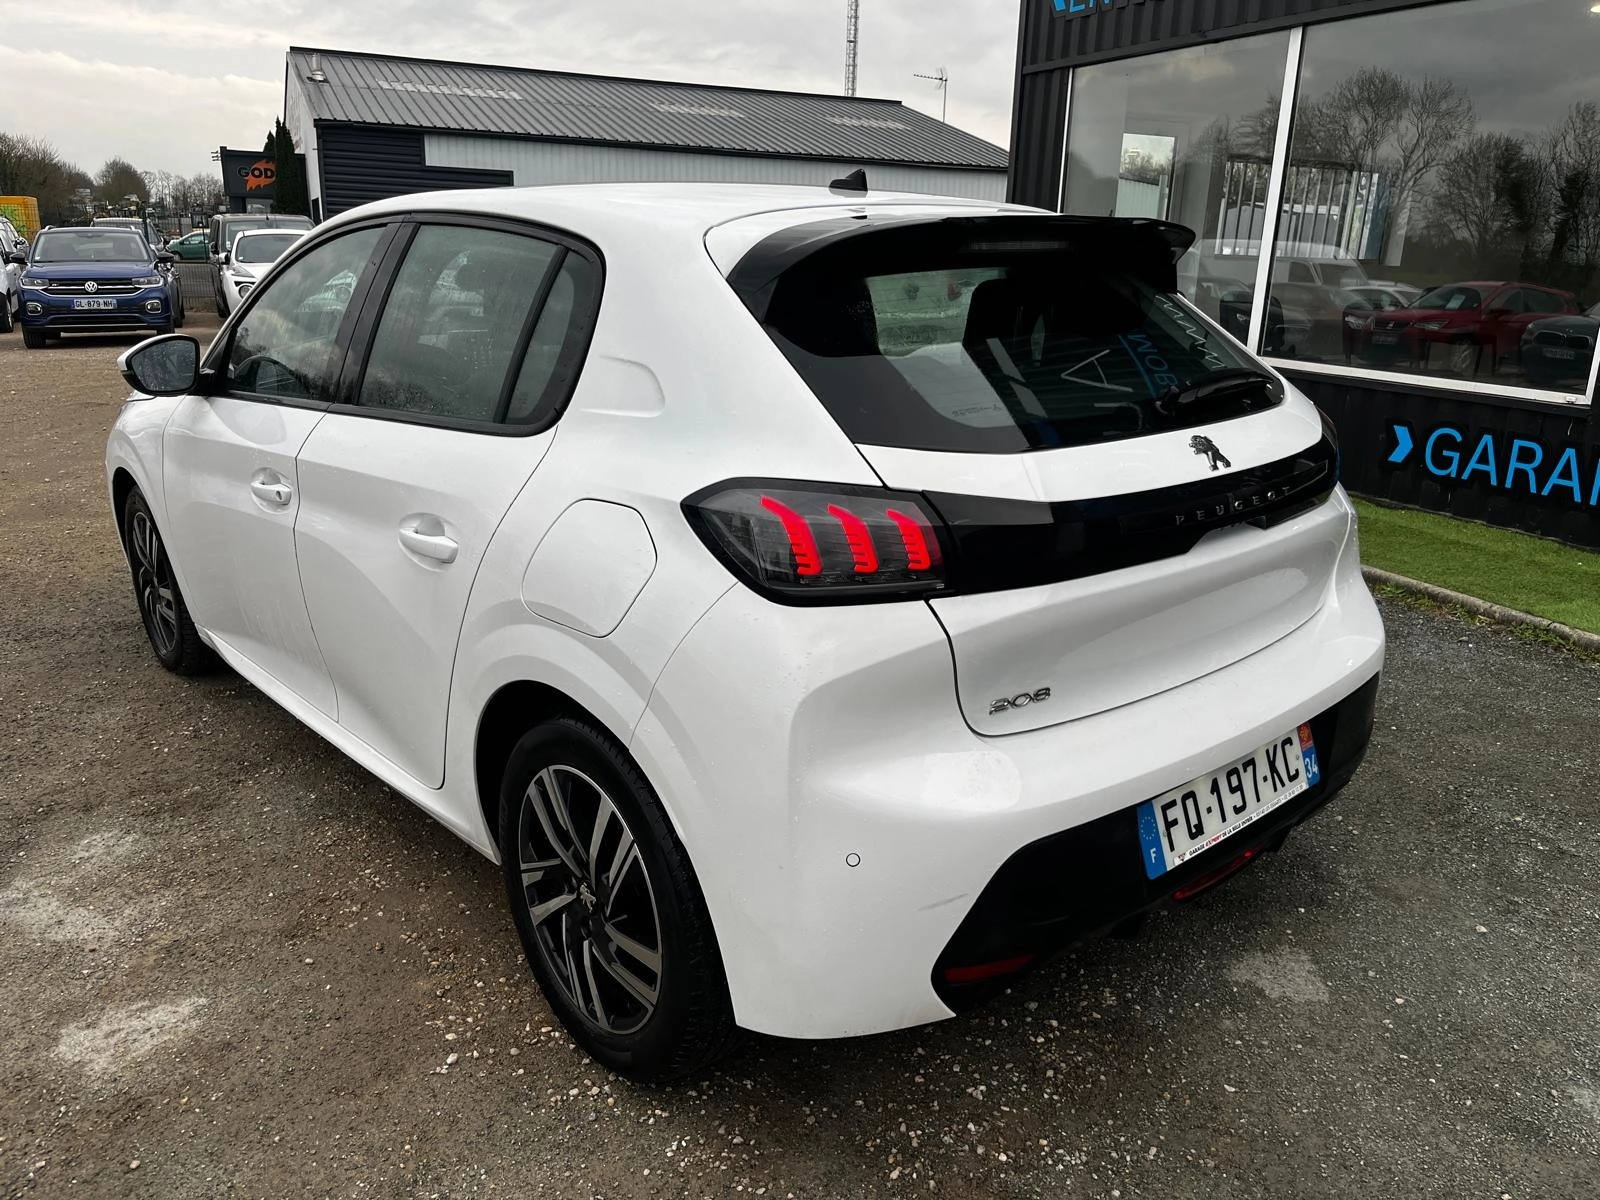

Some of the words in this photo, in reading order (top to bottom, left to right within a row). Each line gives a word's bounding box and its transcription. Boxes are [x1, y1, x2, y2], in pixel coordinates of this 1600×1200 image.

[1175, 485, 1291, 526] PEUGEOT
[988, 687, 1051, 715] 208
[1304, 753, 1319, 779] 34
[1160, 736, 1300, 852] FQ-197-KC
[1150, 847, 1157, 864] F
